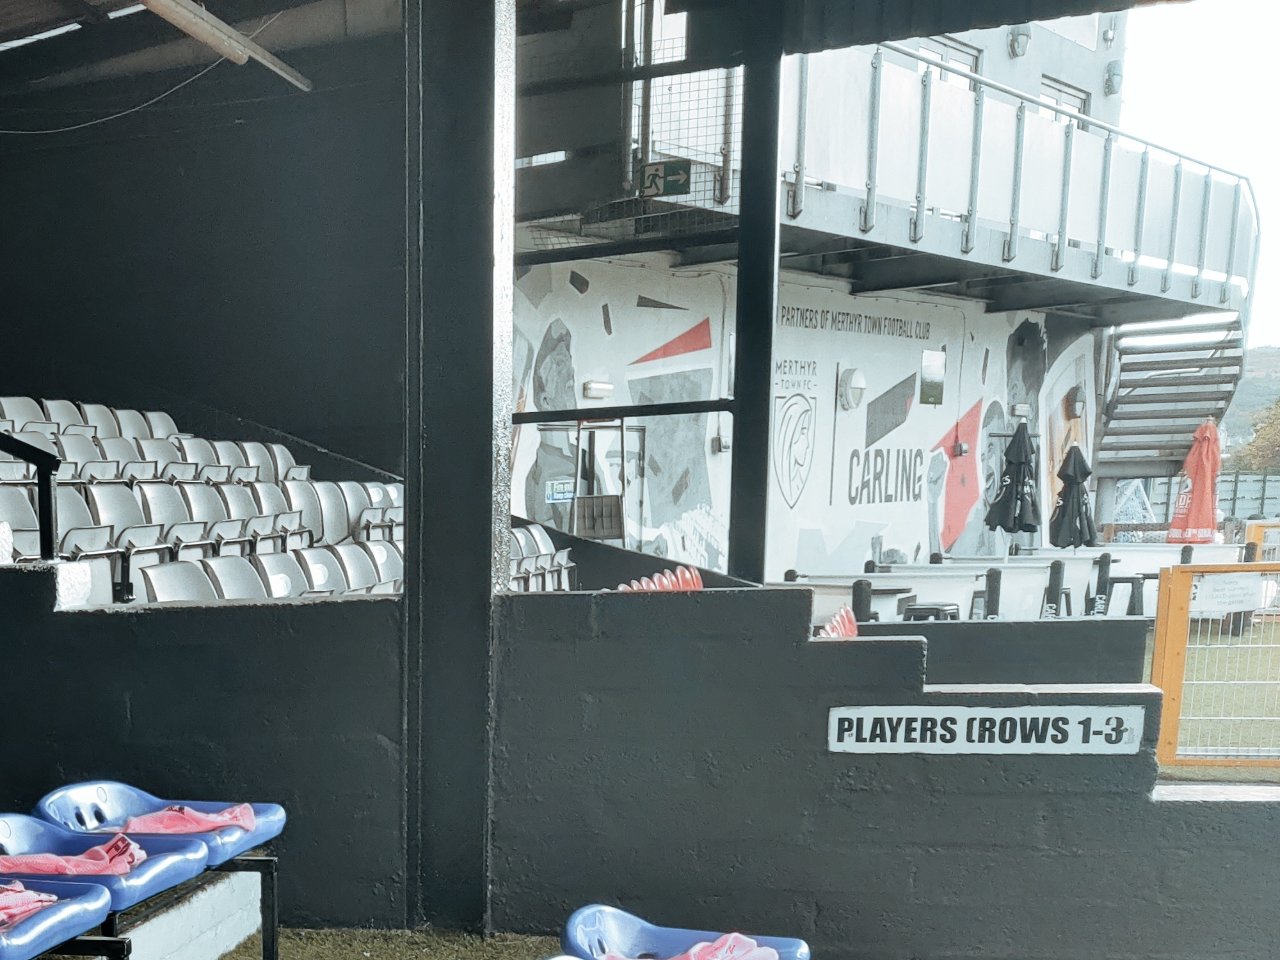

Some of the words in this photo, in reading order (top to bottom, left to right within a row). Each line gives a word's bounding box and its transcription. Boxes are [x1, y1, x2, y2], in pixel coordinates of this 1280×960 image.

[781, 305, 819, 330] PARTNERS
[820, 309, 830, 330] OF
[831, 311, 862, 334] MERTHYR
[864, 315, 882, 336] TOWN
[883, 317, 913, 339] FOOTBALL
[914, 321, 931, 340] CLUB
[775, 360, 817, 376] MERTHYR
[780, 379, 801, 390] TOWN
[802, 379, 813, 391] FC
[848, 449, 923, 506] CARLING
[836, 716, 958, 744] PLAYERS
